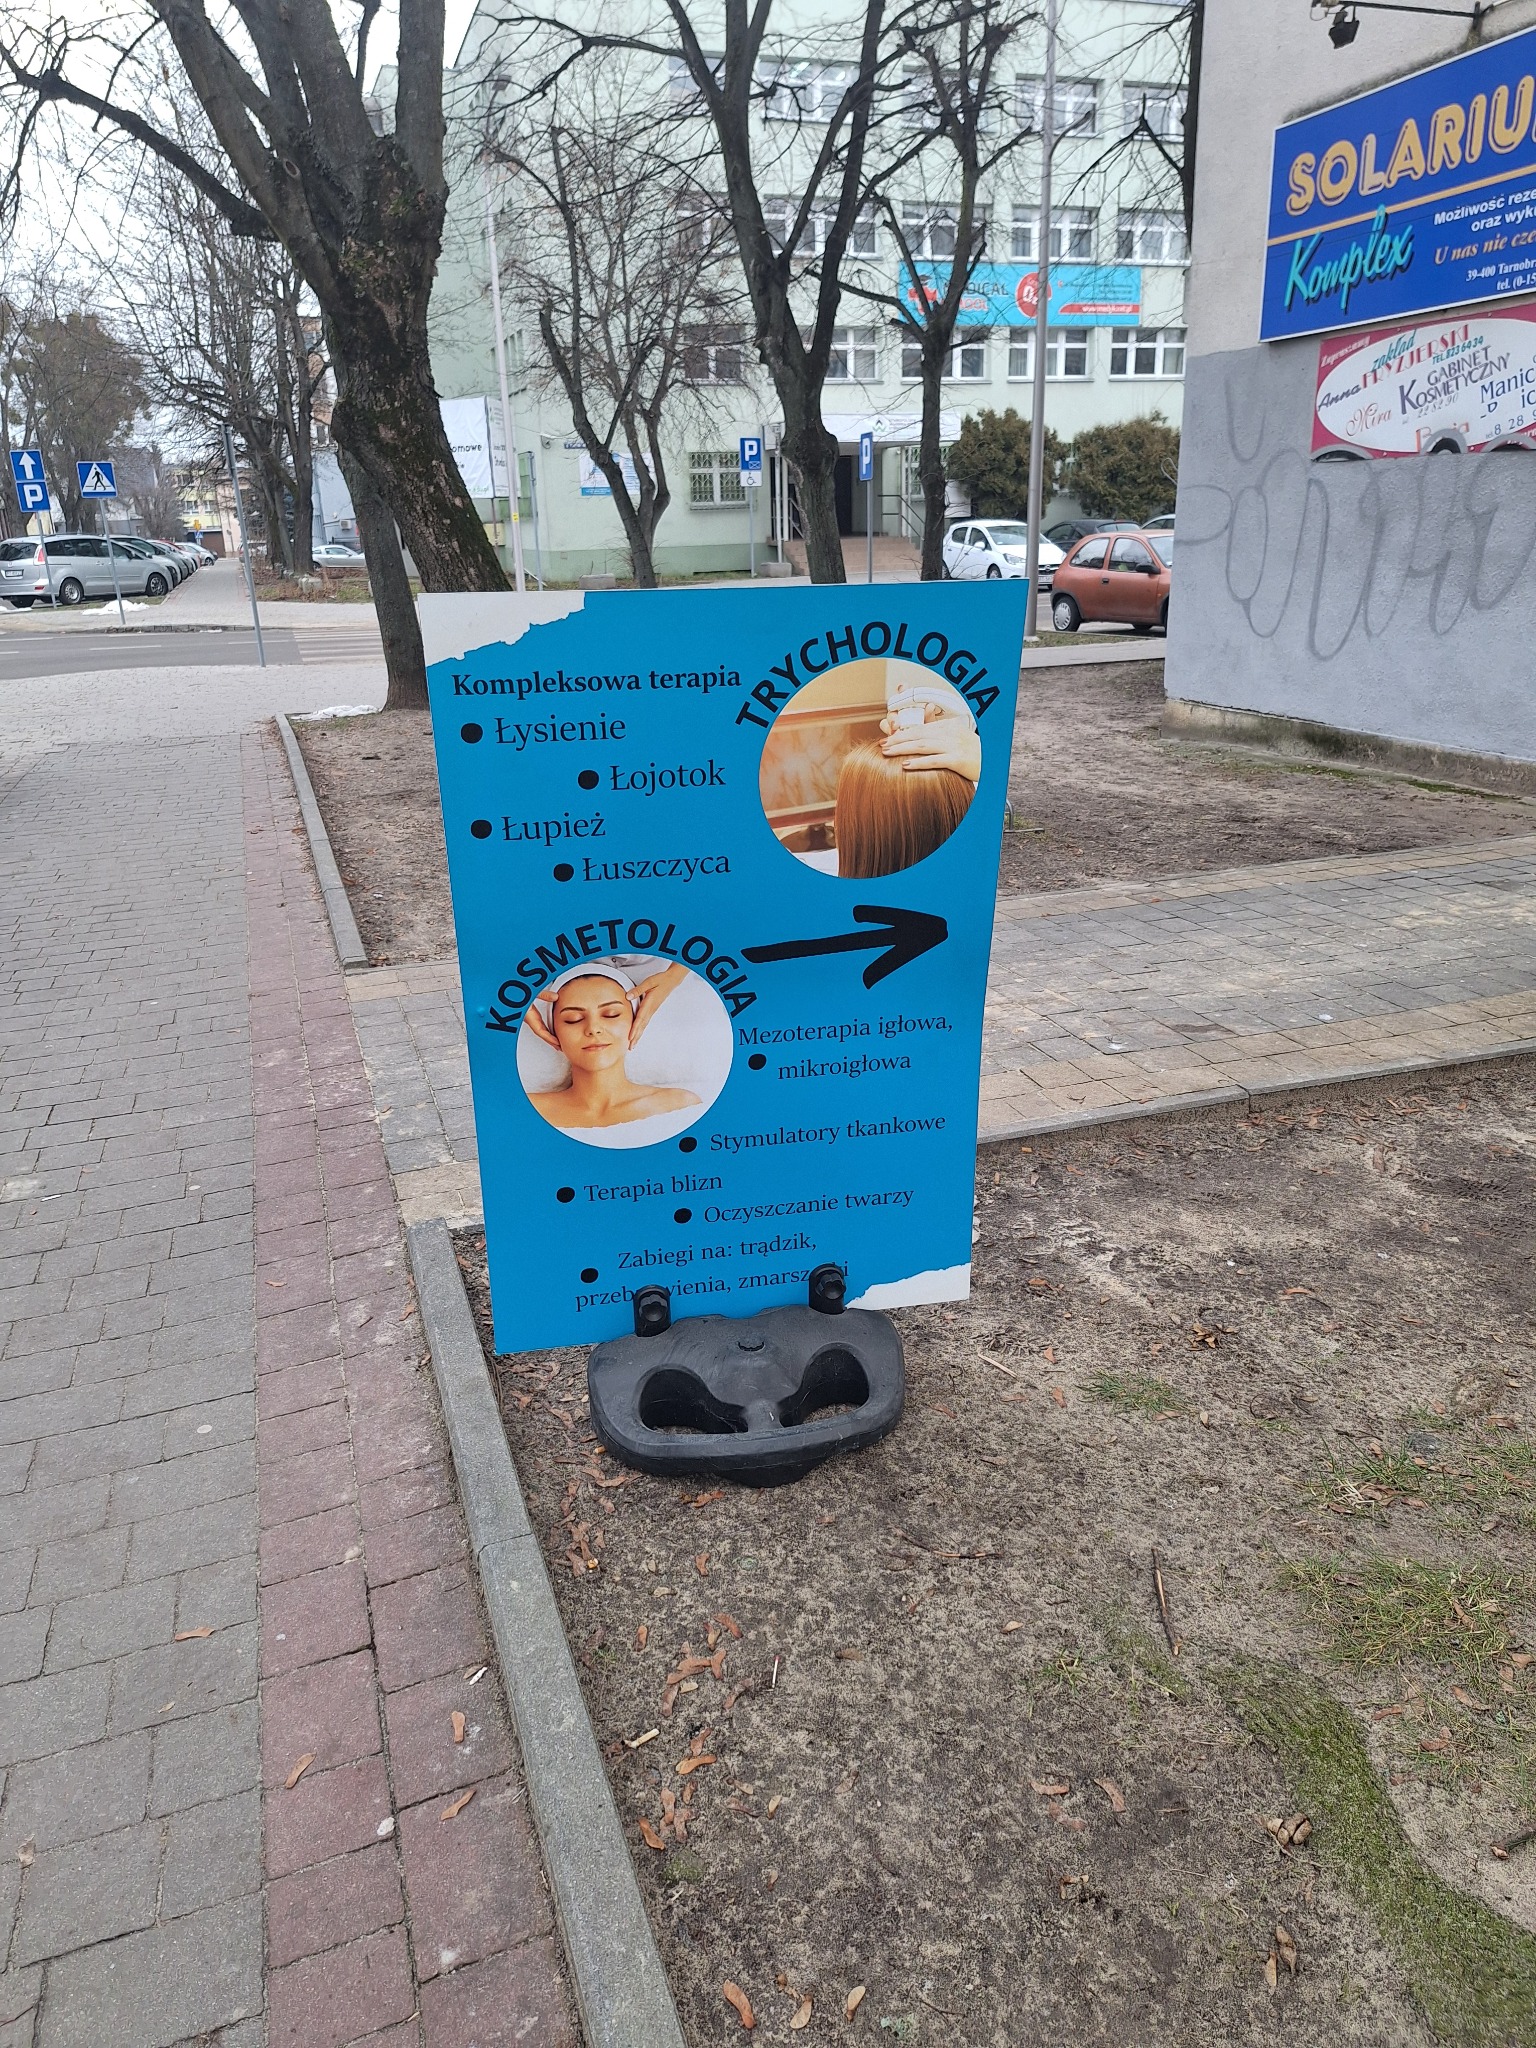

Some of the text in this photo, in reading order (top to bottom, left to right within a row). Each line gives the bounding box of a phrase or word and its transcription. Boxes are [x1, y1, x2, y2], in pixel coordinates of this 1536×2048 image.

[1285, 74, 1536, 216] SOLARIU
[1433, 193, 1505, 225] Możliwość
[1471, 214, 1502, 232] oraz
[1284, 204, 1414, 312] Komplex
[1434, 246, 1449, 265] U
[1450, 243, 1479, 261] nas
[1482, 233, 1508, 253] nie
[1466, 265, 1496, 281] 39-400
[1497, 278, 1511, 291] tel.
[1371, 328, 1418, 372] zakład
[1427, 345, 1491, 386] GABINET
[1318, 324, 1469, 412] Anna FRYZJERSKI
[1399, 352, 1510, 415] KOSMETYCZNY
[1345, 402, 1392, 437] Mira
[744, 440, 758, 462] P
[862, 437, 871, 475] P
[23, 484, 43, 509] P
[451, 665, 742, 700] Kompleksowa terapia
[735, 621, 1000, 729] TRYCHOLOGIA
[494, 712, 627, 751] Łysienie
[609, 759, 726, 797] Łojotok
[501, 812, 606, 847] Łupież
[582, 855, 731, 883] Łuszczyca
[485, 919, 757, 1034] KOSMETOLOGIA
[738, 1014, 953, 1046] Mezoterapia igłowa,
[777, 1054, 912, 1080] mikroigłowa
[710, 1116, 946, 1154] Stymulatory tkankowe
[584, 1174, 724, 1203] Terapia blizn
[704, 1190, 914, 1224] Oczyszczanie twarzy
[617, 1232, 817, 1269] Zabiegi na: trądzik,
[575, 1261, 849, 1312] przebwienia, zmarszi
